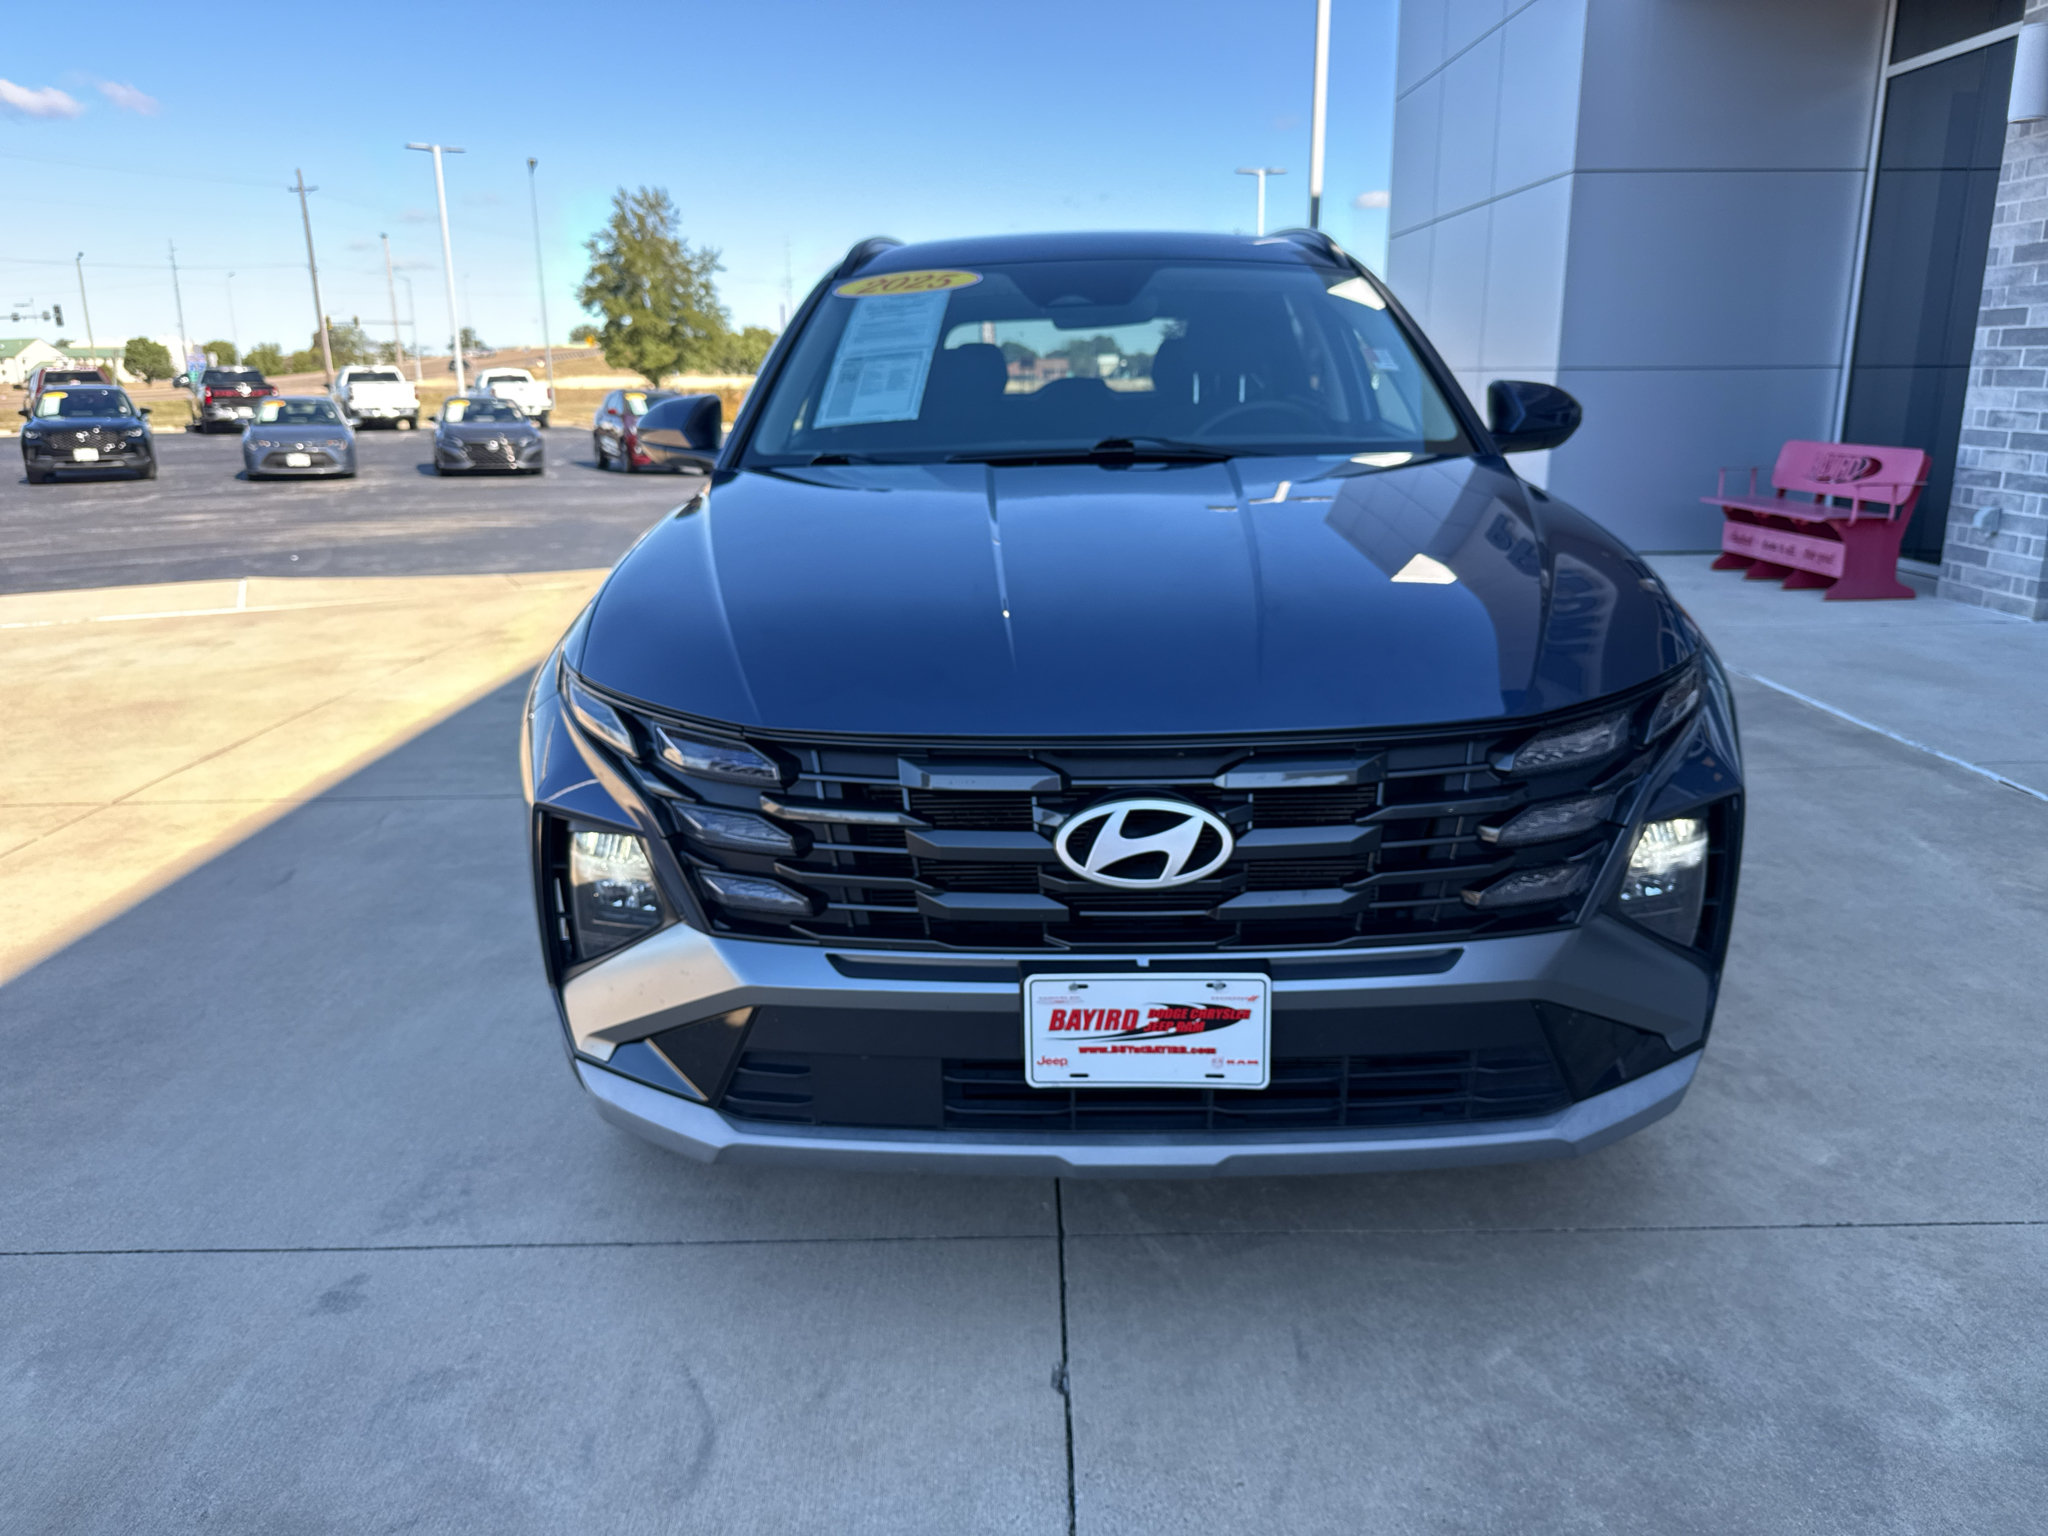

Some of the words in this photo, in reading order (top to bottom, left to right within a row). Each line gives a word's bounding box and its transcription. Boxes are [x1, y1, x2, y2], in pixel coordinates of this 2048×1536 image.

[856, 273, 961, 294] 2025
[1048, 1008, 1140, 1031] BAYIRD
[1147, 1008, 1189, 1020] DODGE
[1190, 1008, 1252, 1020] CHRYSLER
[1143, 1020, 1174, 1032] JEEP
[1175, 1021, 1206, 1033] RAM
[1036, 1056, 1068, 1067] Jeep
